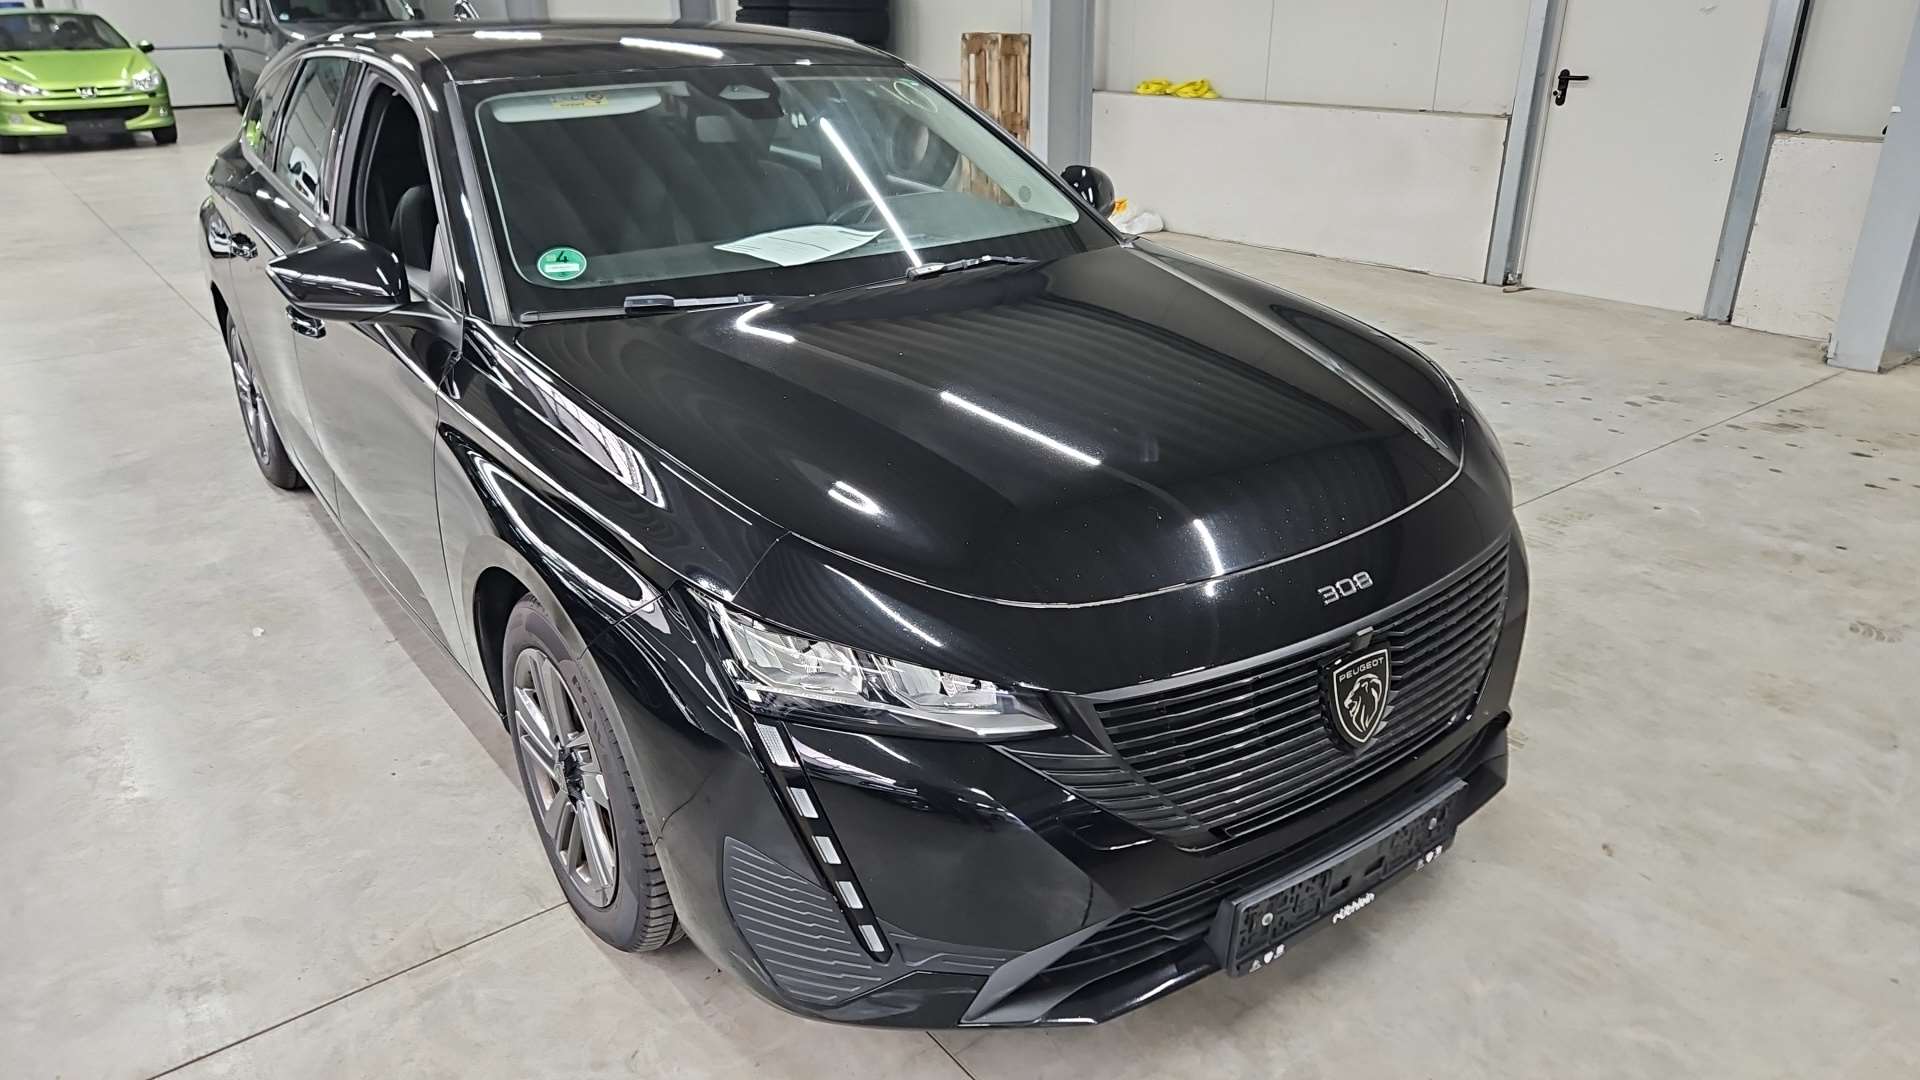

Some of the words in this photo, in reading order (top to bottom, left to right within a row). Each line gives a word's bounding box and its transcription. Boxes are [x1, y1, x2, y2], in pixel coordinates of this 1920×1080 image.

[556, 250, 568, 263] 4
[1317, 571, 1373, 605] 308
[1339, 656, 1384, 682] PEUGEOT
